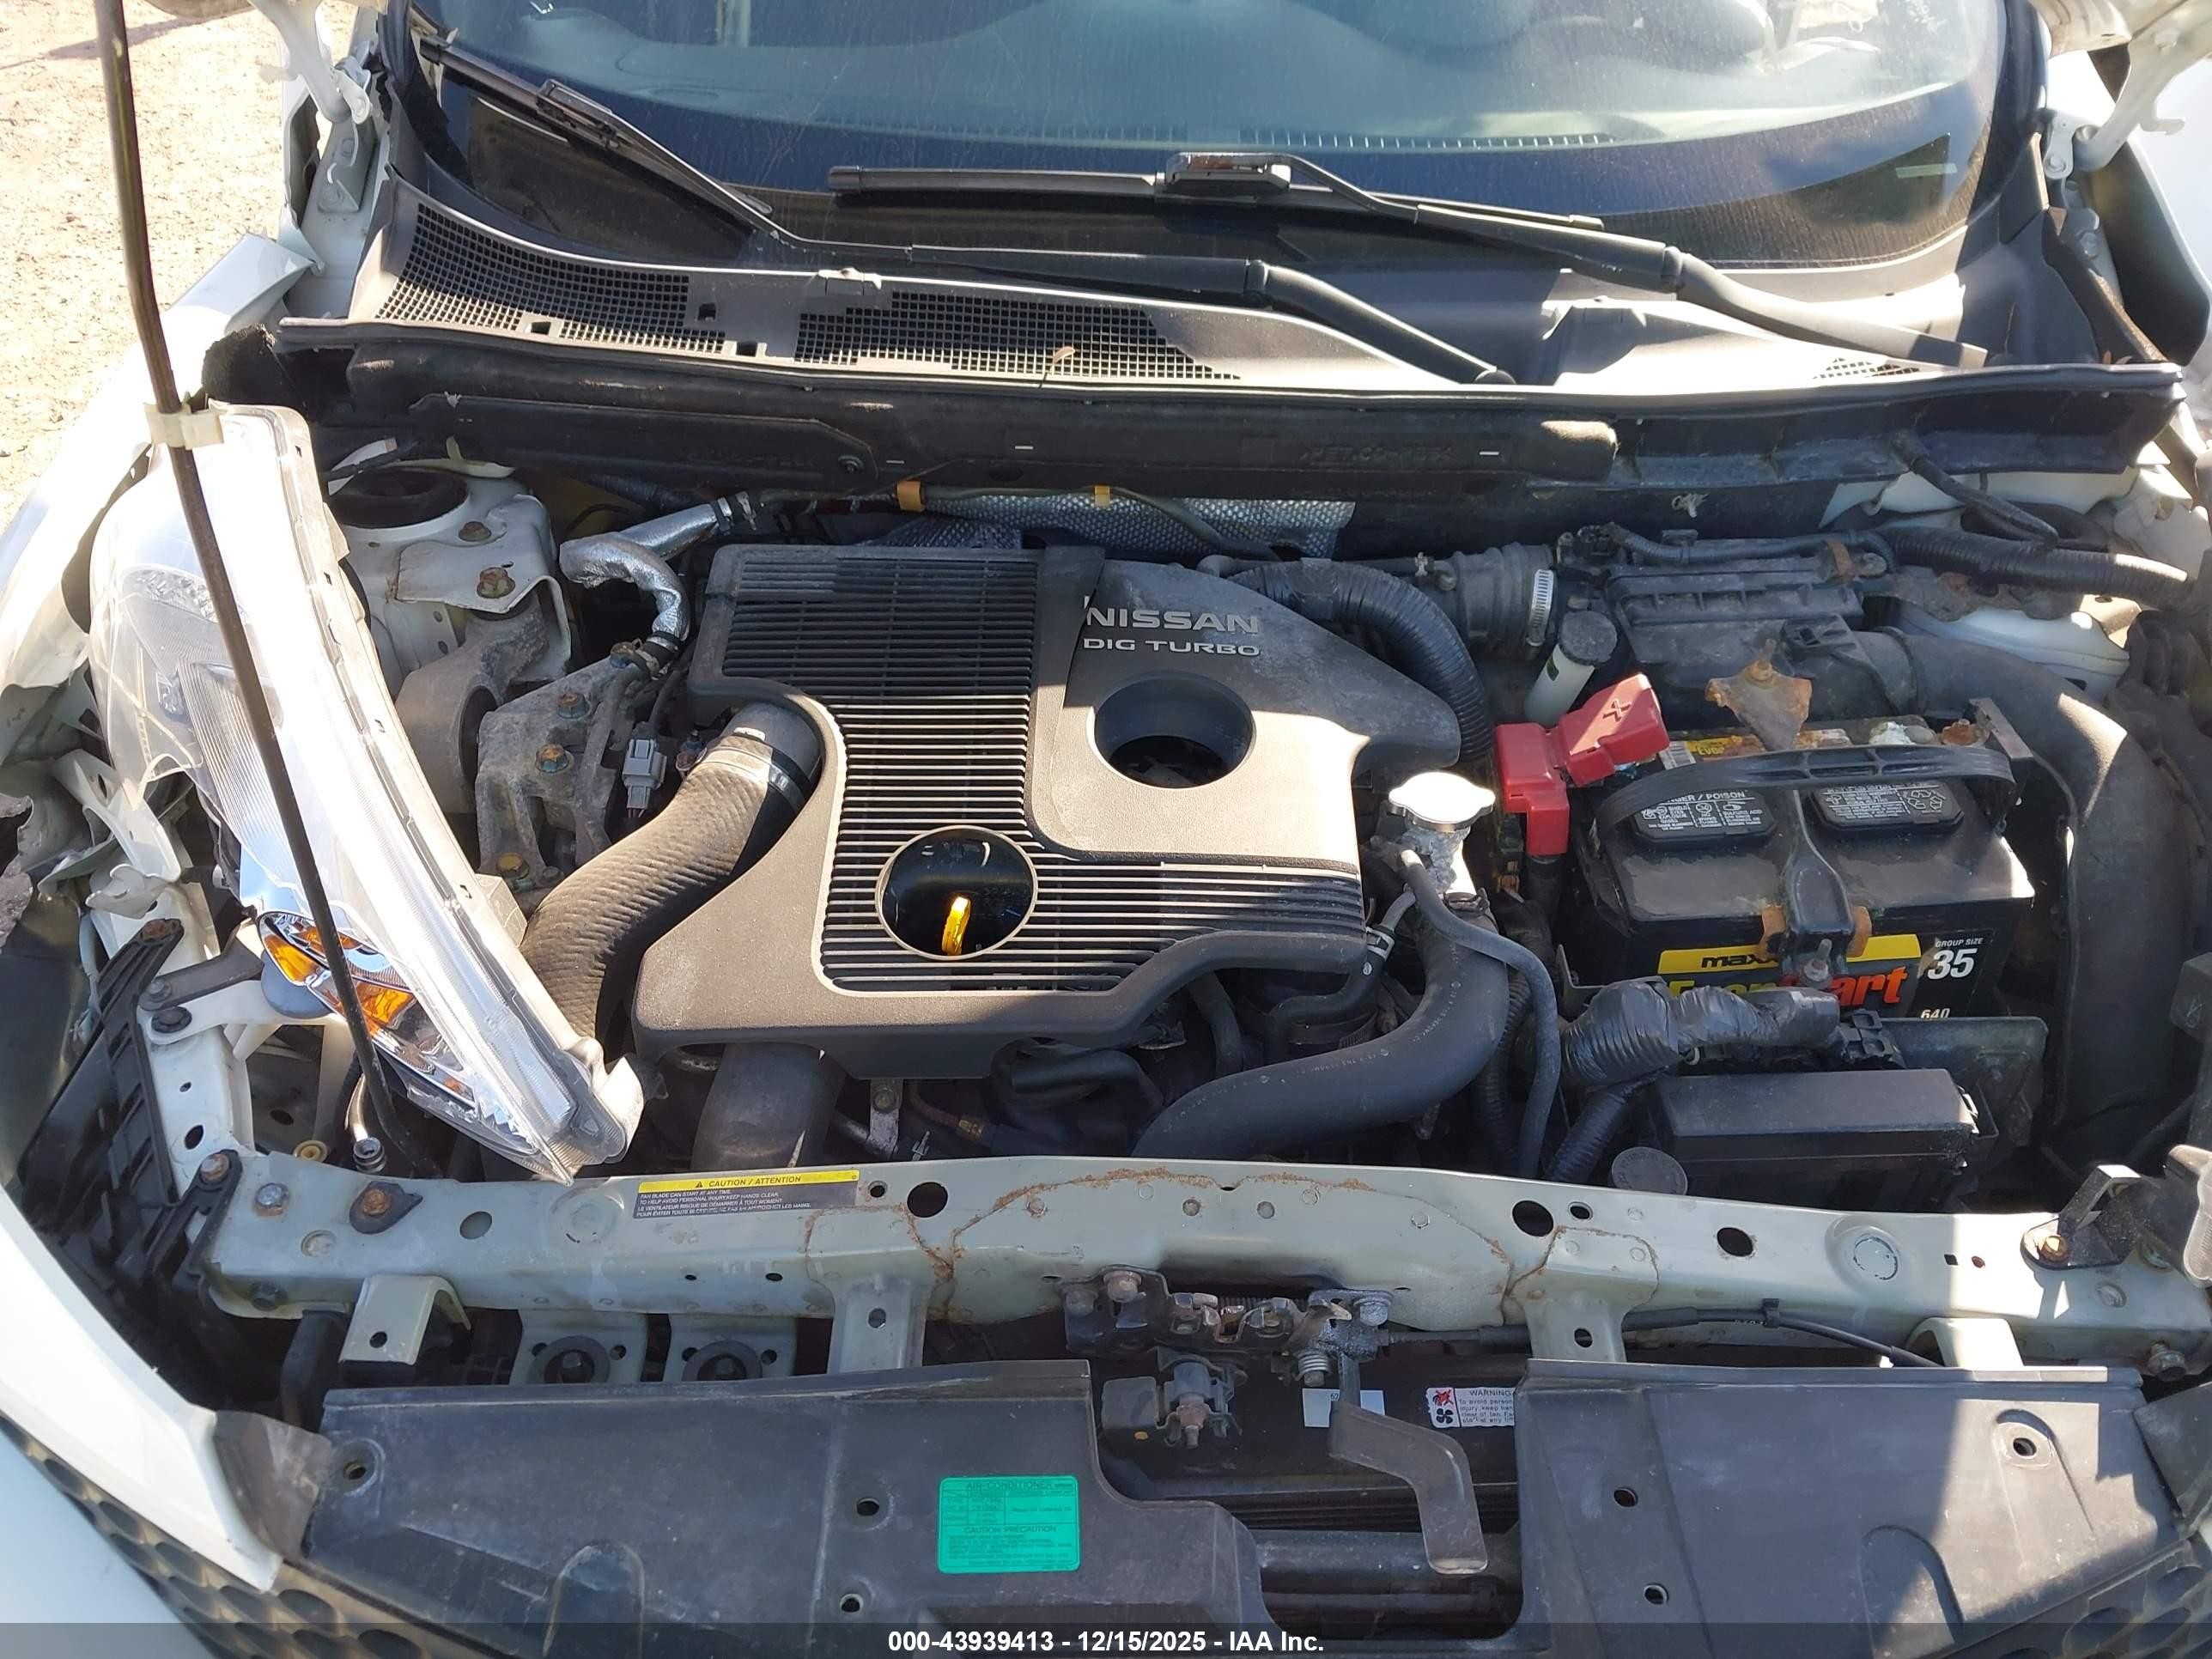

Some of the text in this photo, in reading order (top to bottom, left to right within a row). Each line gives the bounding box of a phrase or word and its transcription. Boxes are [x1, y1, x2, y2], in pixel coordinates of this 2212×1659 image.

[1086, 607, 1259, 634] NISSAN
[1083, 638, 1261, 657] DIG TURBO
[1705, 791, 1746, 800] POISON
[1936, 939, 1964, 948] GROUP
[1927, 948, 1978, 980] 35
[1920, 1007, 1951, 1019] 640
[708, 1178, 746, 1188] CAUTION
[755, 1176, 801, 1185] ATTENTION
